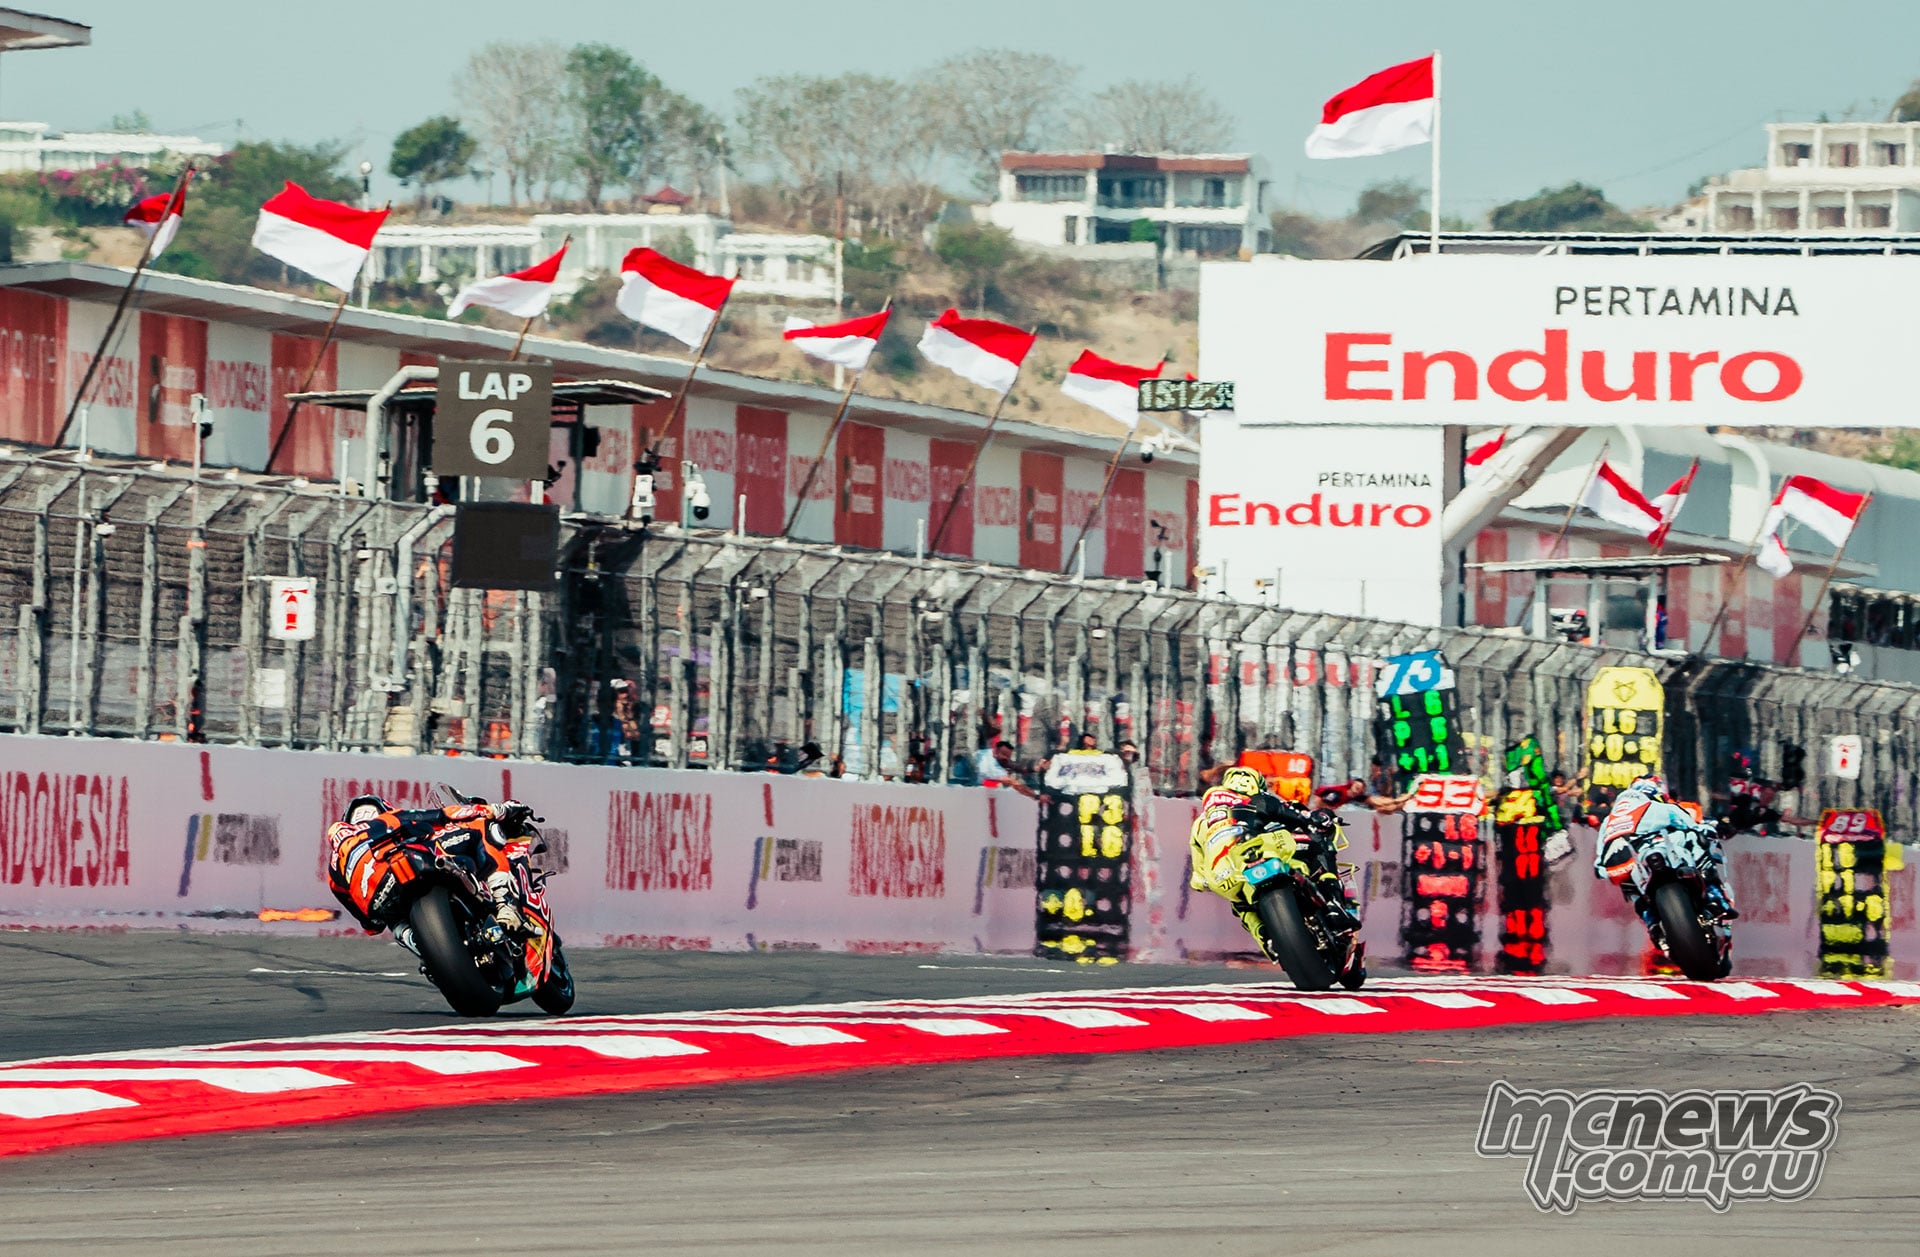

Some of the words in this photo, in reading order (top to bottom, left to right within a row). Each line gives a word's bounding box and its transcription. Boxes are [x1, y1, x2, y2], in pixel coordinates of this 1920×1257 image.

[1556, 287, 1800, 317] PERTAMINA
[1325, 329, 1805, 403] Enduro
[459, 372, 533, 401] LAP
[470, 410, 516, 465] 6
[1319, 472, 1432, 488] PERTAMINA
[1209, 493, 1433, 529] Enduro
[1385, 650, 1442, 698] 73
[1415, 777, 1478, 808] 93
[605, 790, 714, 893] INDONESIA
